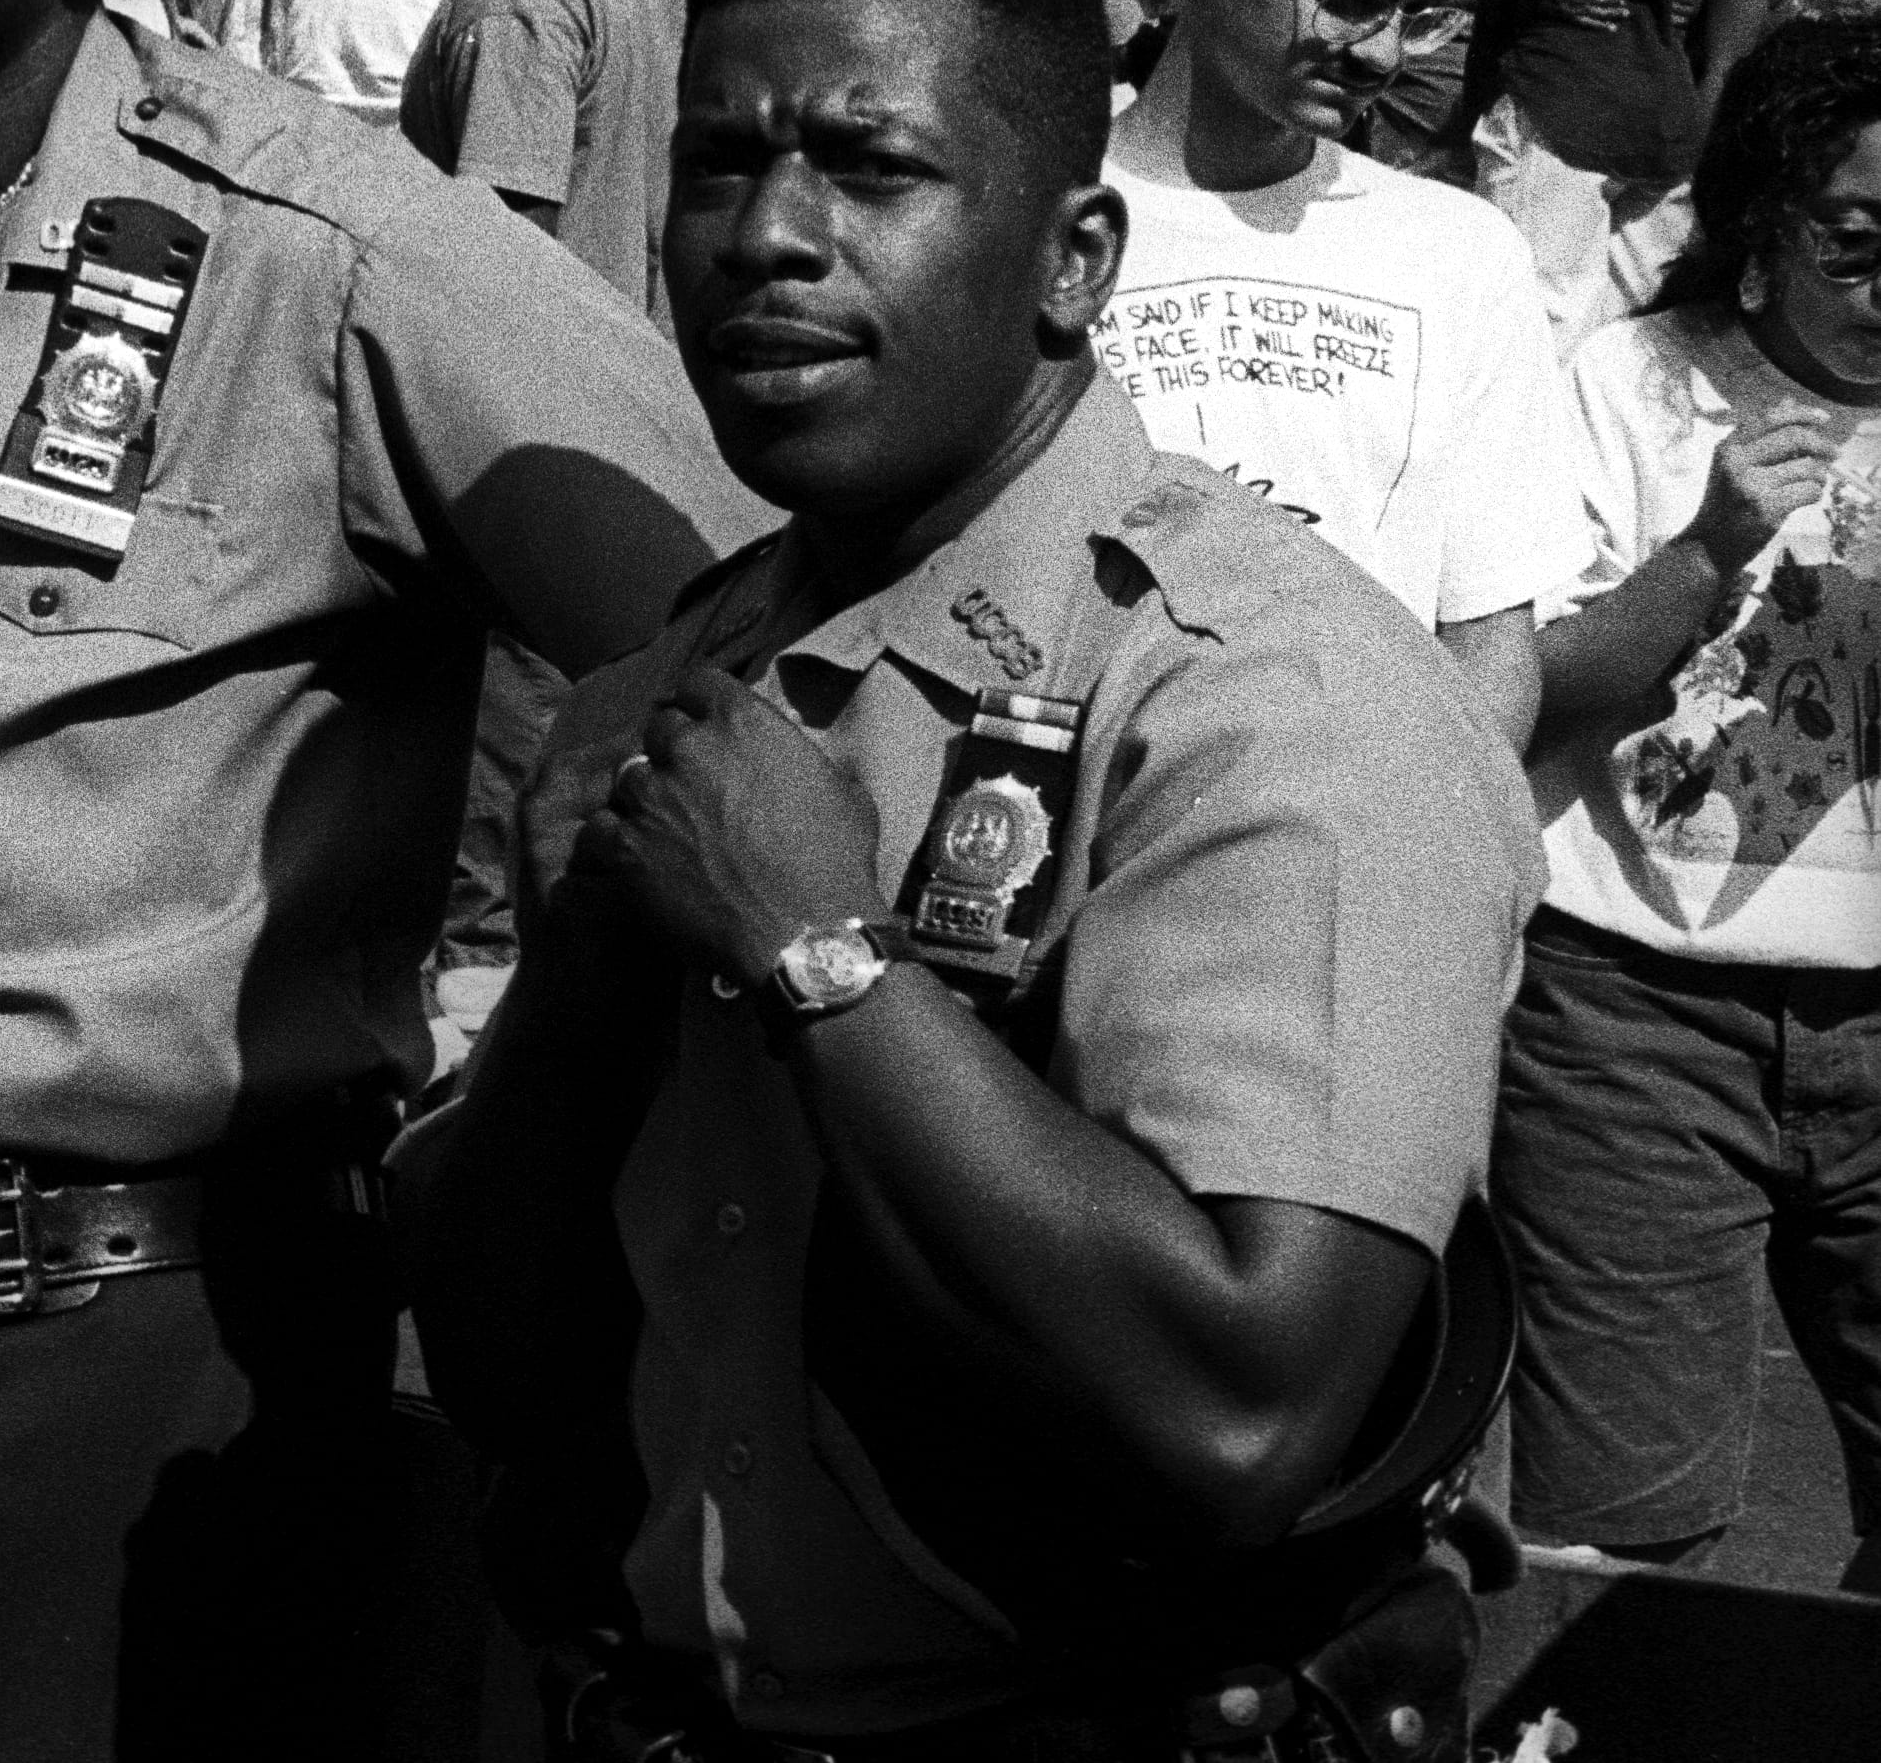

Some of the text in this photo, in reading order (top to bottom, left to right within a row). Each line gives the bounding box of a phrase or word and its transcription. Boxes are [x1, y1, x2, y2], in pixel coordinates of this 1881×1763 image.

[1126, 298, 1182, 329] SAID
[1190, 291, 1214, 320] IF
[1223, 290, 1240, 318] I
[1249, 293, 1308, 327] KEEP
[1317, 301, 1395, 343] MAKING
[1097, 340, 1127, 369] IS
[1220, 324, 1243, 352] IT
[1254, 331, 1304, 358] WILL
[1313, 333, 1395, 378] FREEZE
[1154, 361, 1210, 394] THIS
[1217, 355, 1345, 397] FOREVER!
